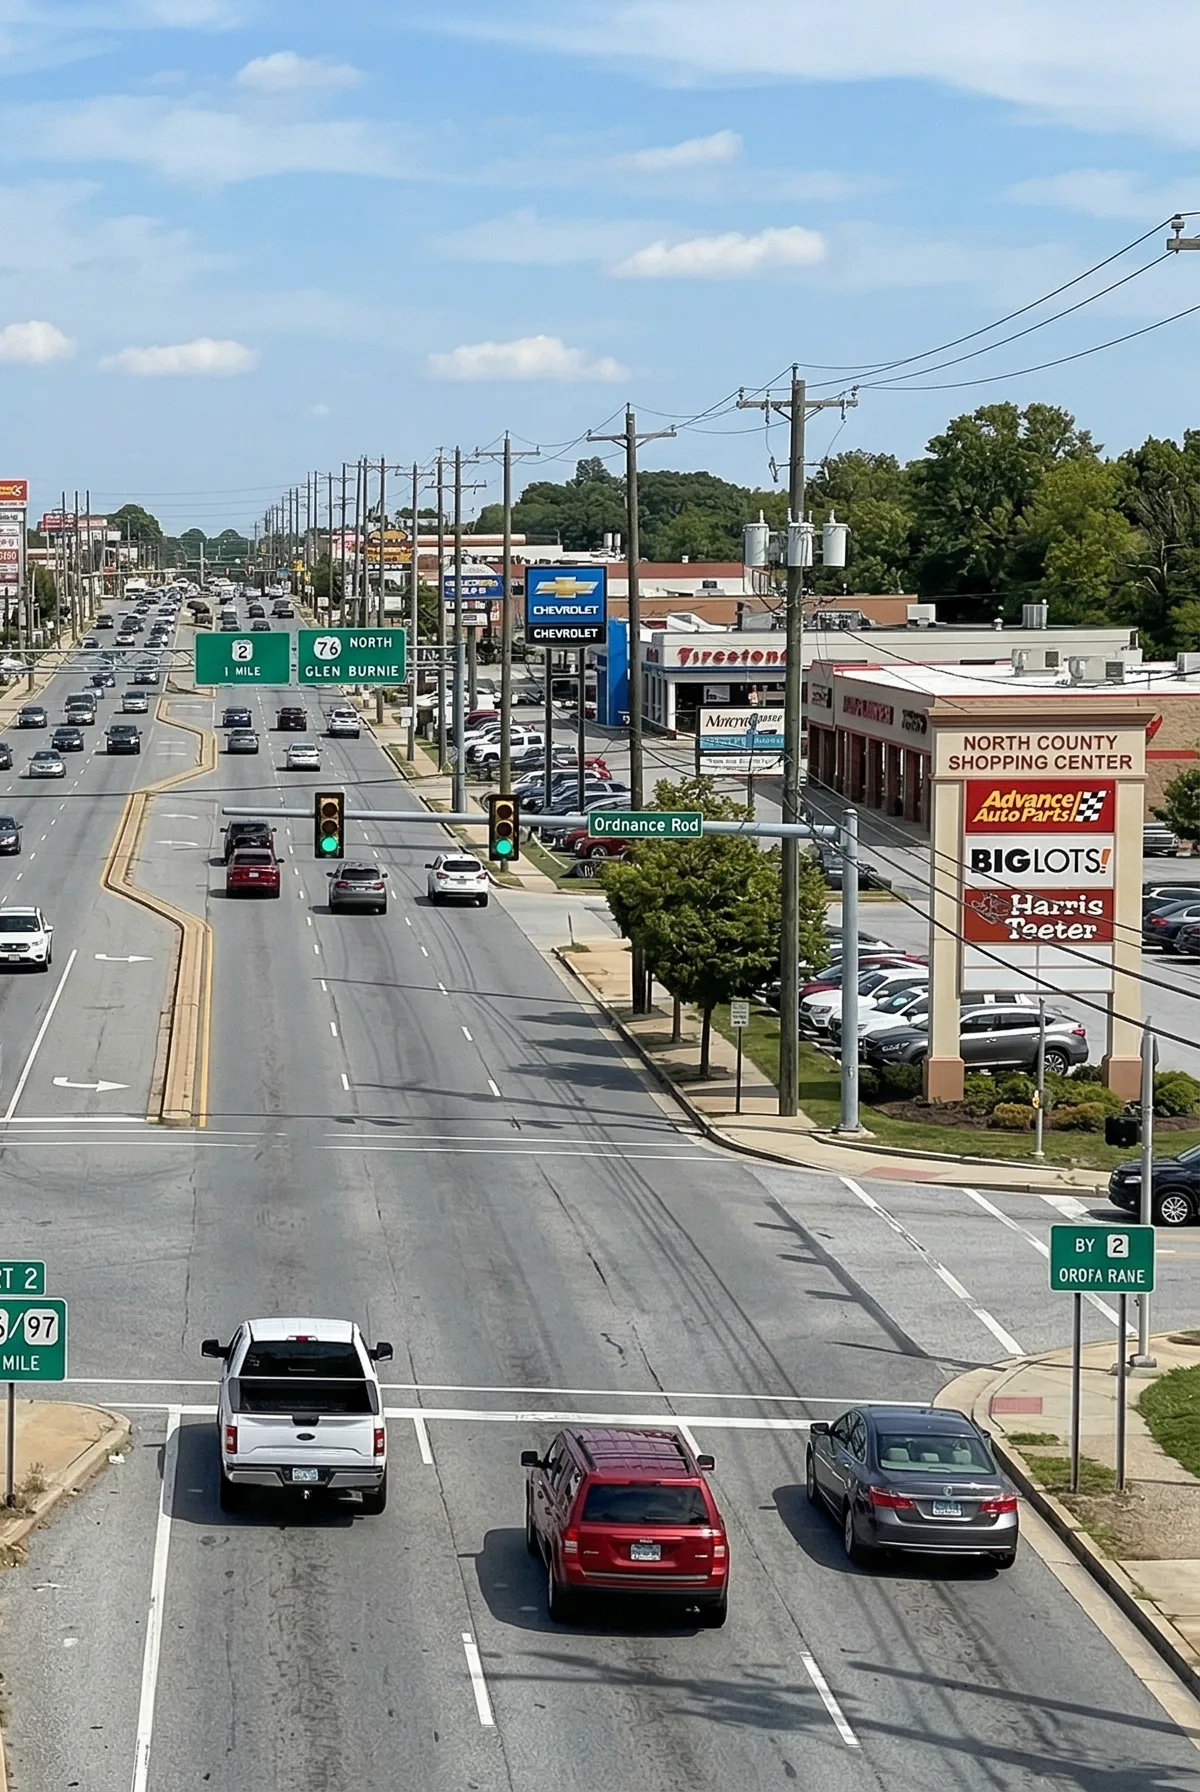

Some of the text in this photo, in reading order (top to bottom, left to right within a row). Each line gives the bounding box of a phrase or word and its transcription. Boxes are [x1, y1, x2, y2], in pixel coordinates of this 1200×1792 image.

[533, 605, 599, 615] CHEVROLET
[533, 629, 598, 638] CHEVROLET
[238, 645, 248, 658] 2
[317, 637, 392, 655] 76 NORTH
[224, 667, 261, 676] 1 MILE
[305, 665, 399, 677] GLEN BURNIE
[964, 735, 1118, 750] NORTH COUNTY
[948, 755, 1132, 770] SHOPPING CENTER
[981, 790, 1073, 808] Advance
[972, 808, 1070, 823] Auto Parts
[594, 817, 699, 832] Ordnance Rod
[1010, 894, 1103, 916] Harris
[1005, 918, 1097, 939] Teeter
[1075, 1238, 1124, 1253] BY 2
[24, 1267, 38, 1289] 2
[1059, 1268, 1145, 1283] OROFA RANE
[2, 1355, 40, 1371] MILE
